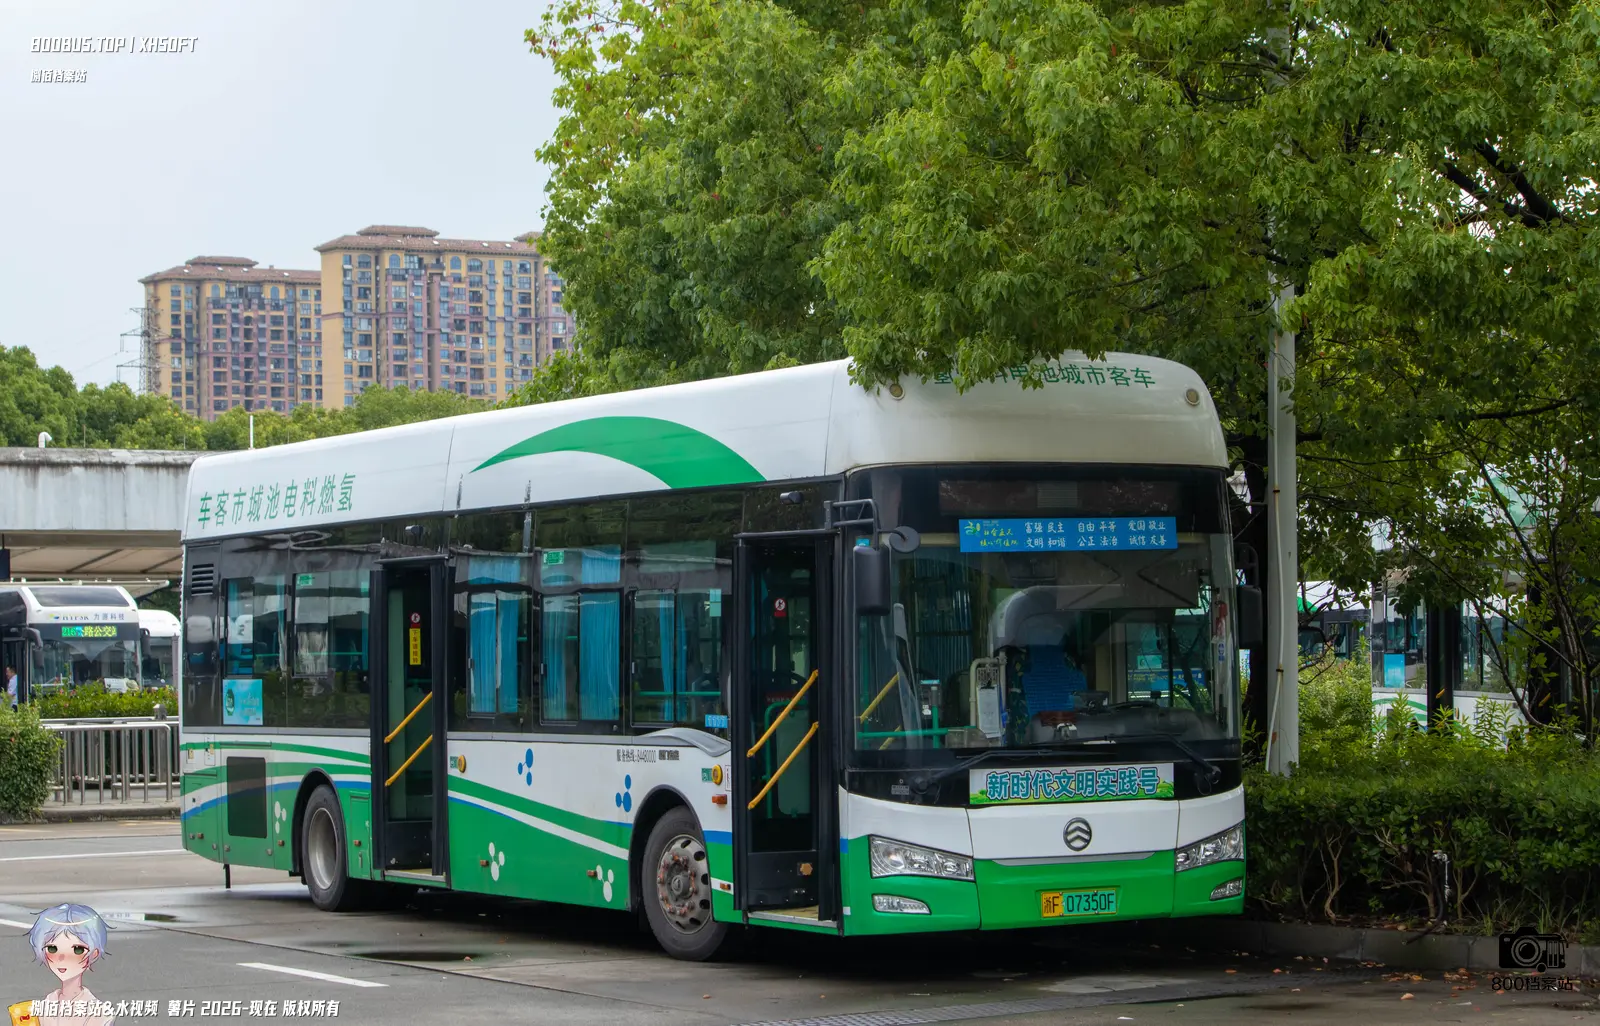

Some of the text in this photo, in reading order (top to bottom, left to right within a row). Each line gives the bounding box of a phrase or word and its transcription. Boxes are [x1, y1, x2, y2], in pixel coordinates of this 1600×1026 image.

[1024, 521, 1043, 533] 富强
[1048, 521, 1065, 533] 民主
[1078, 521, 1095, 532] 自由
[1099, 520, 1117, 532] 平等
[1128, 520, 1146, 531] 爱国
[1026, 534, 1167, 548] 文明 和谐 公正 法治 诚信 友善
[987, 767, 1160, 799] 新时代文明实践号
